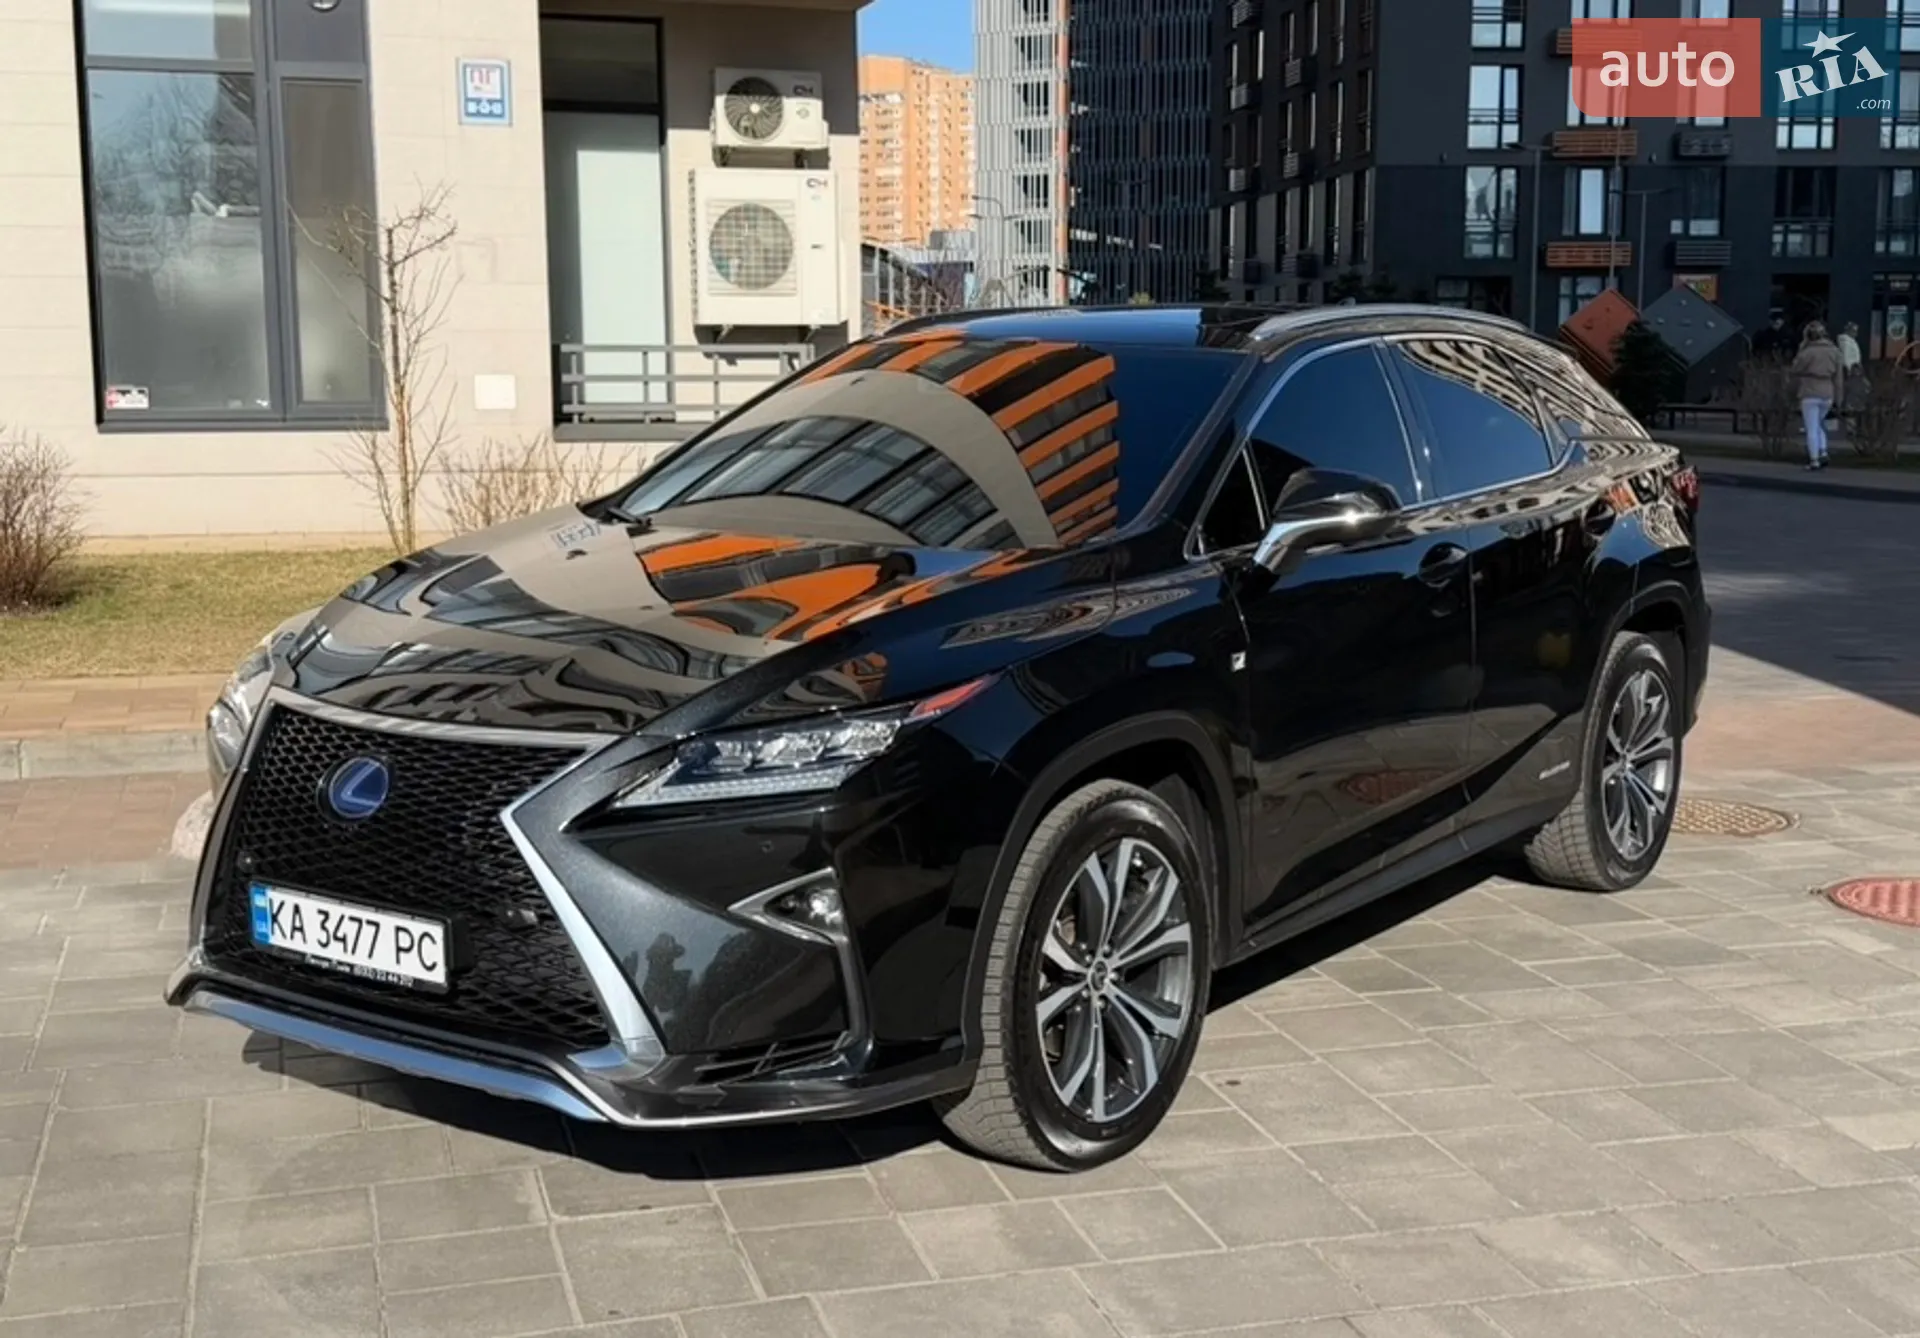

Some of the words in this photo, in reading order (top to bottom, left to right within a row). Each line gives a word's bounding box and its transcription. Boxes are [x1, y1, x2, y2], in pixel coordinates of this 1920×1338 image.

[268, 898, 307, 944] KA
[317, 908, 381, 960] 3477
[394, 925, 438, 972] PC
